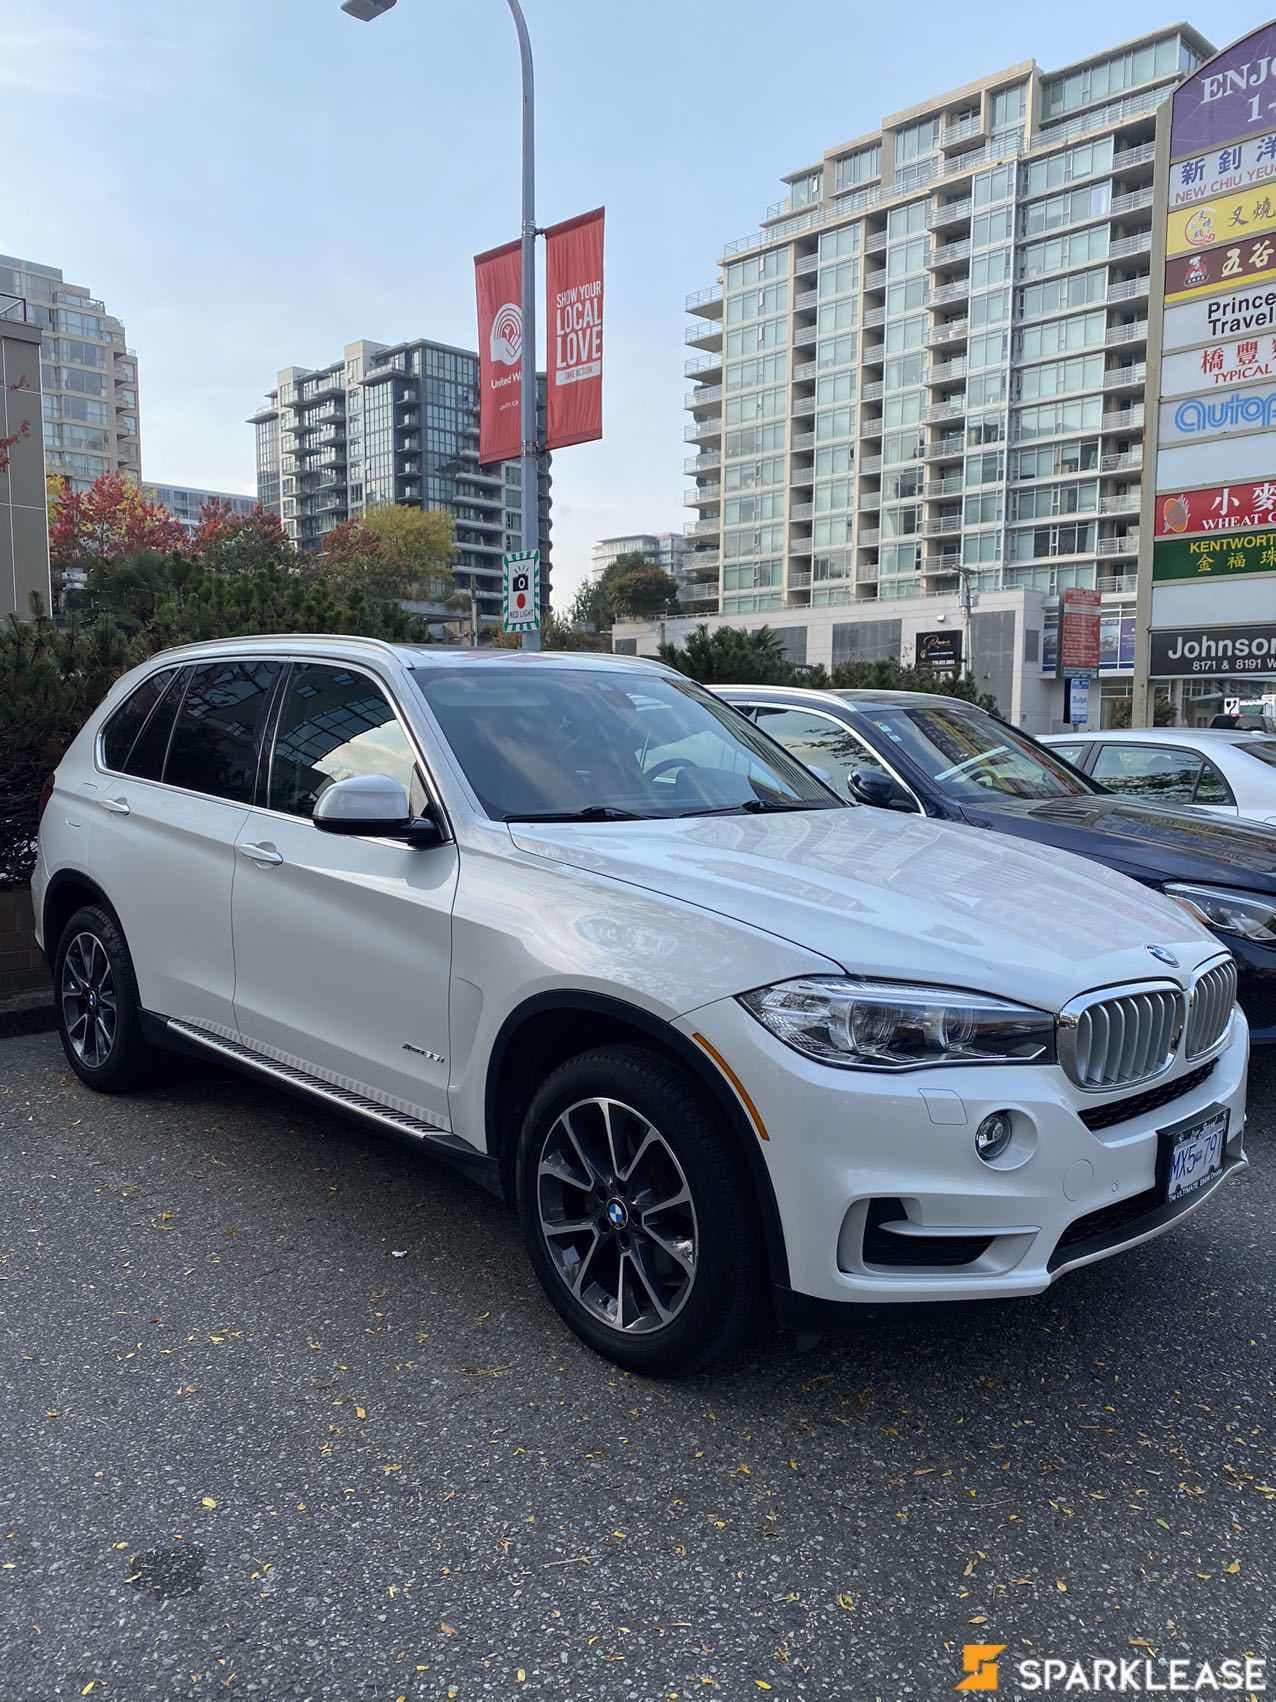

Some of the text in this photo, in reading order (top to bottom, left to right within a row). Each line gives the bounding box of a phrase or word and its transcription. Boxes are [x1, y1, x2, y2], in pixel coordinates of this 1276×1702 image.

[1175, 163, 1276, 203] NEW CHIU YEU
[556, 281, 601, 308] SHOW YOUR
[556, 298, 601, 336] LOCAL
[1208, 306, 1273, 336] Travel
[556, 326, 601, 368] LOVE
[1201, 338, 1276, 374] 橋豐
[491, 375, 511, 389] United
[1214, 363, 1272, 383] TYPICAL
[1202, 514, 1262, 530] WHEAT
[1192, 661, 1216, 671] 8171
[1221, 660, 1229, 669] &
[1235, 659, 1261, 669] 8191
